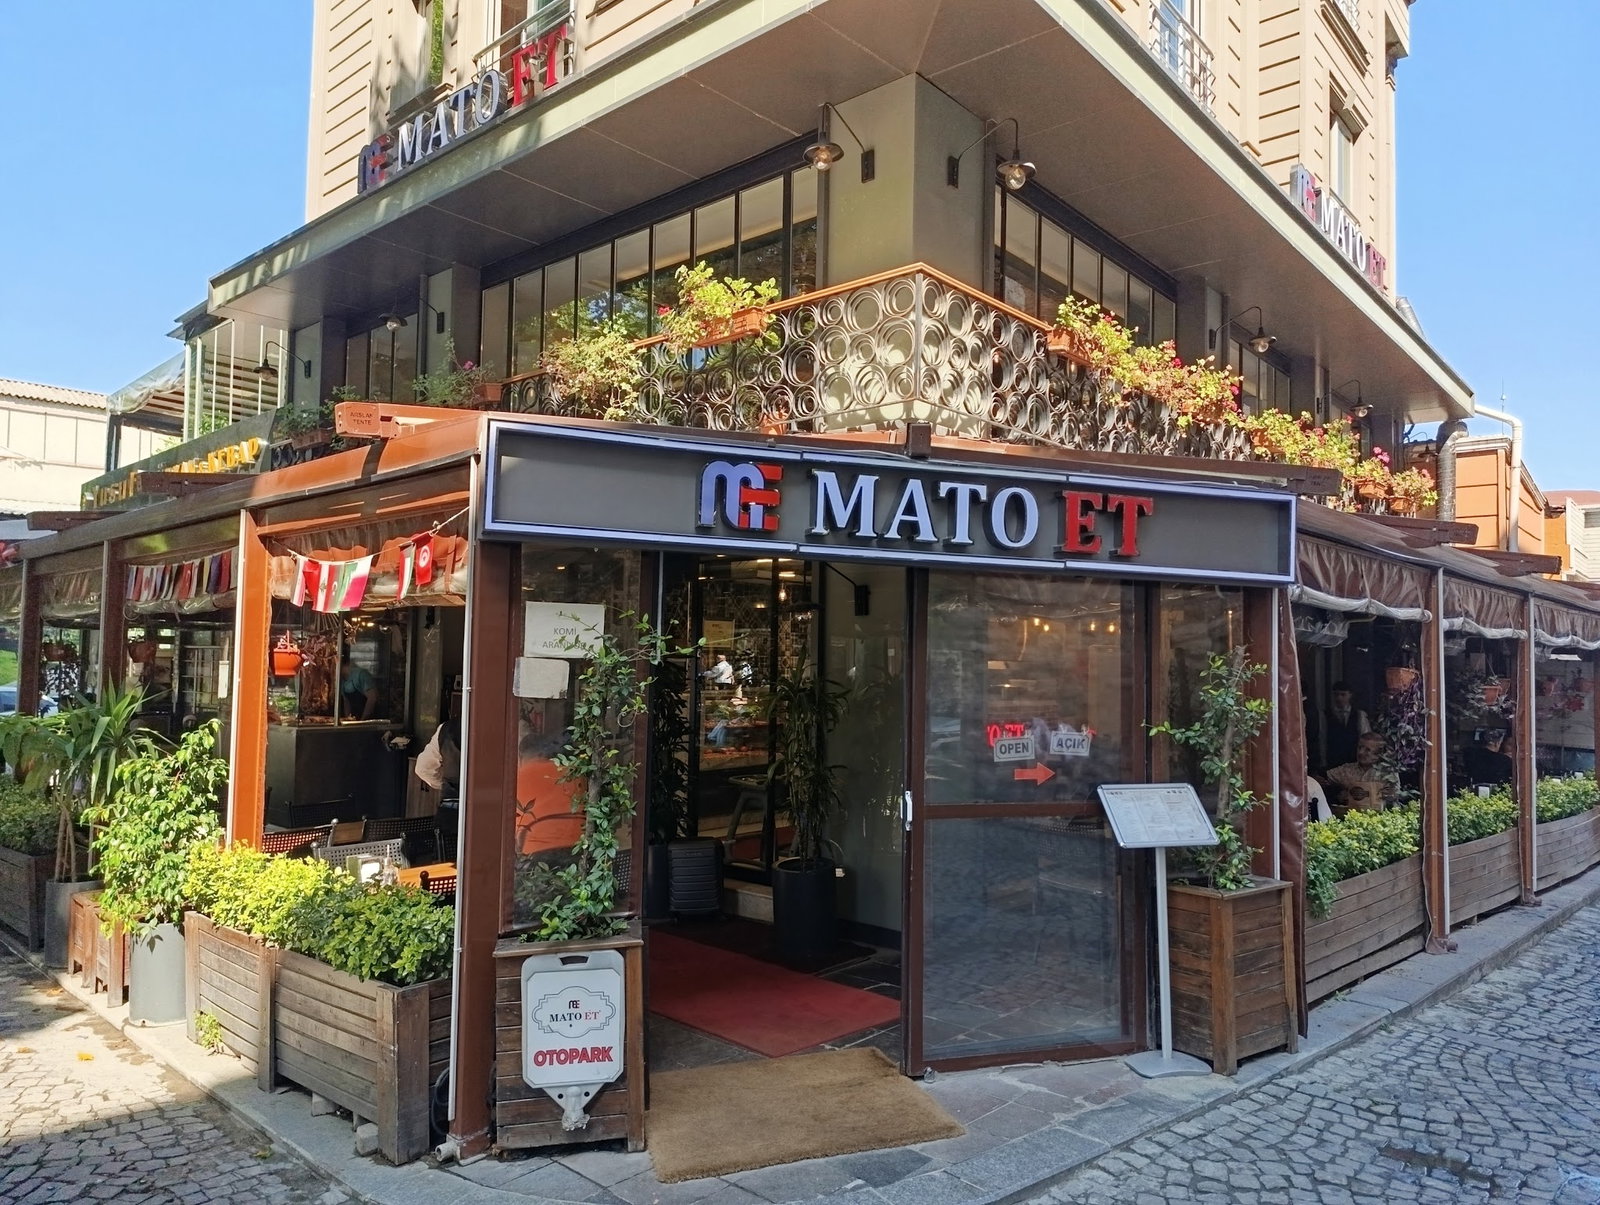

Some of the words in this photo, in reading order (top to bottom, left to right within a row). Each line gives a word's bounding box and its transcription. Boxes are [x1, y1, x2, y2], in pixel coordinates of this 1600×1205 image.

[397, 69, 503, 172] MATO
[511, 23, 569, 107] ET
[1320, 189, 1366, 272] MATO
[1369, 243, 1387, 291] ET
[808, 468, 1040, 549] MATO
[1059, 489, 1154, 558] ET
[553, 627, 577, 636] KOMİ
[999, 742, 1030, 755] OPEN
[1056, 738, 1086, 752] AÇIK
[549, 1012, 582, 1023] MATO
[585, 1011, 600, 1020] ET
[533, 1046, 613, 1067] OTOPARK
